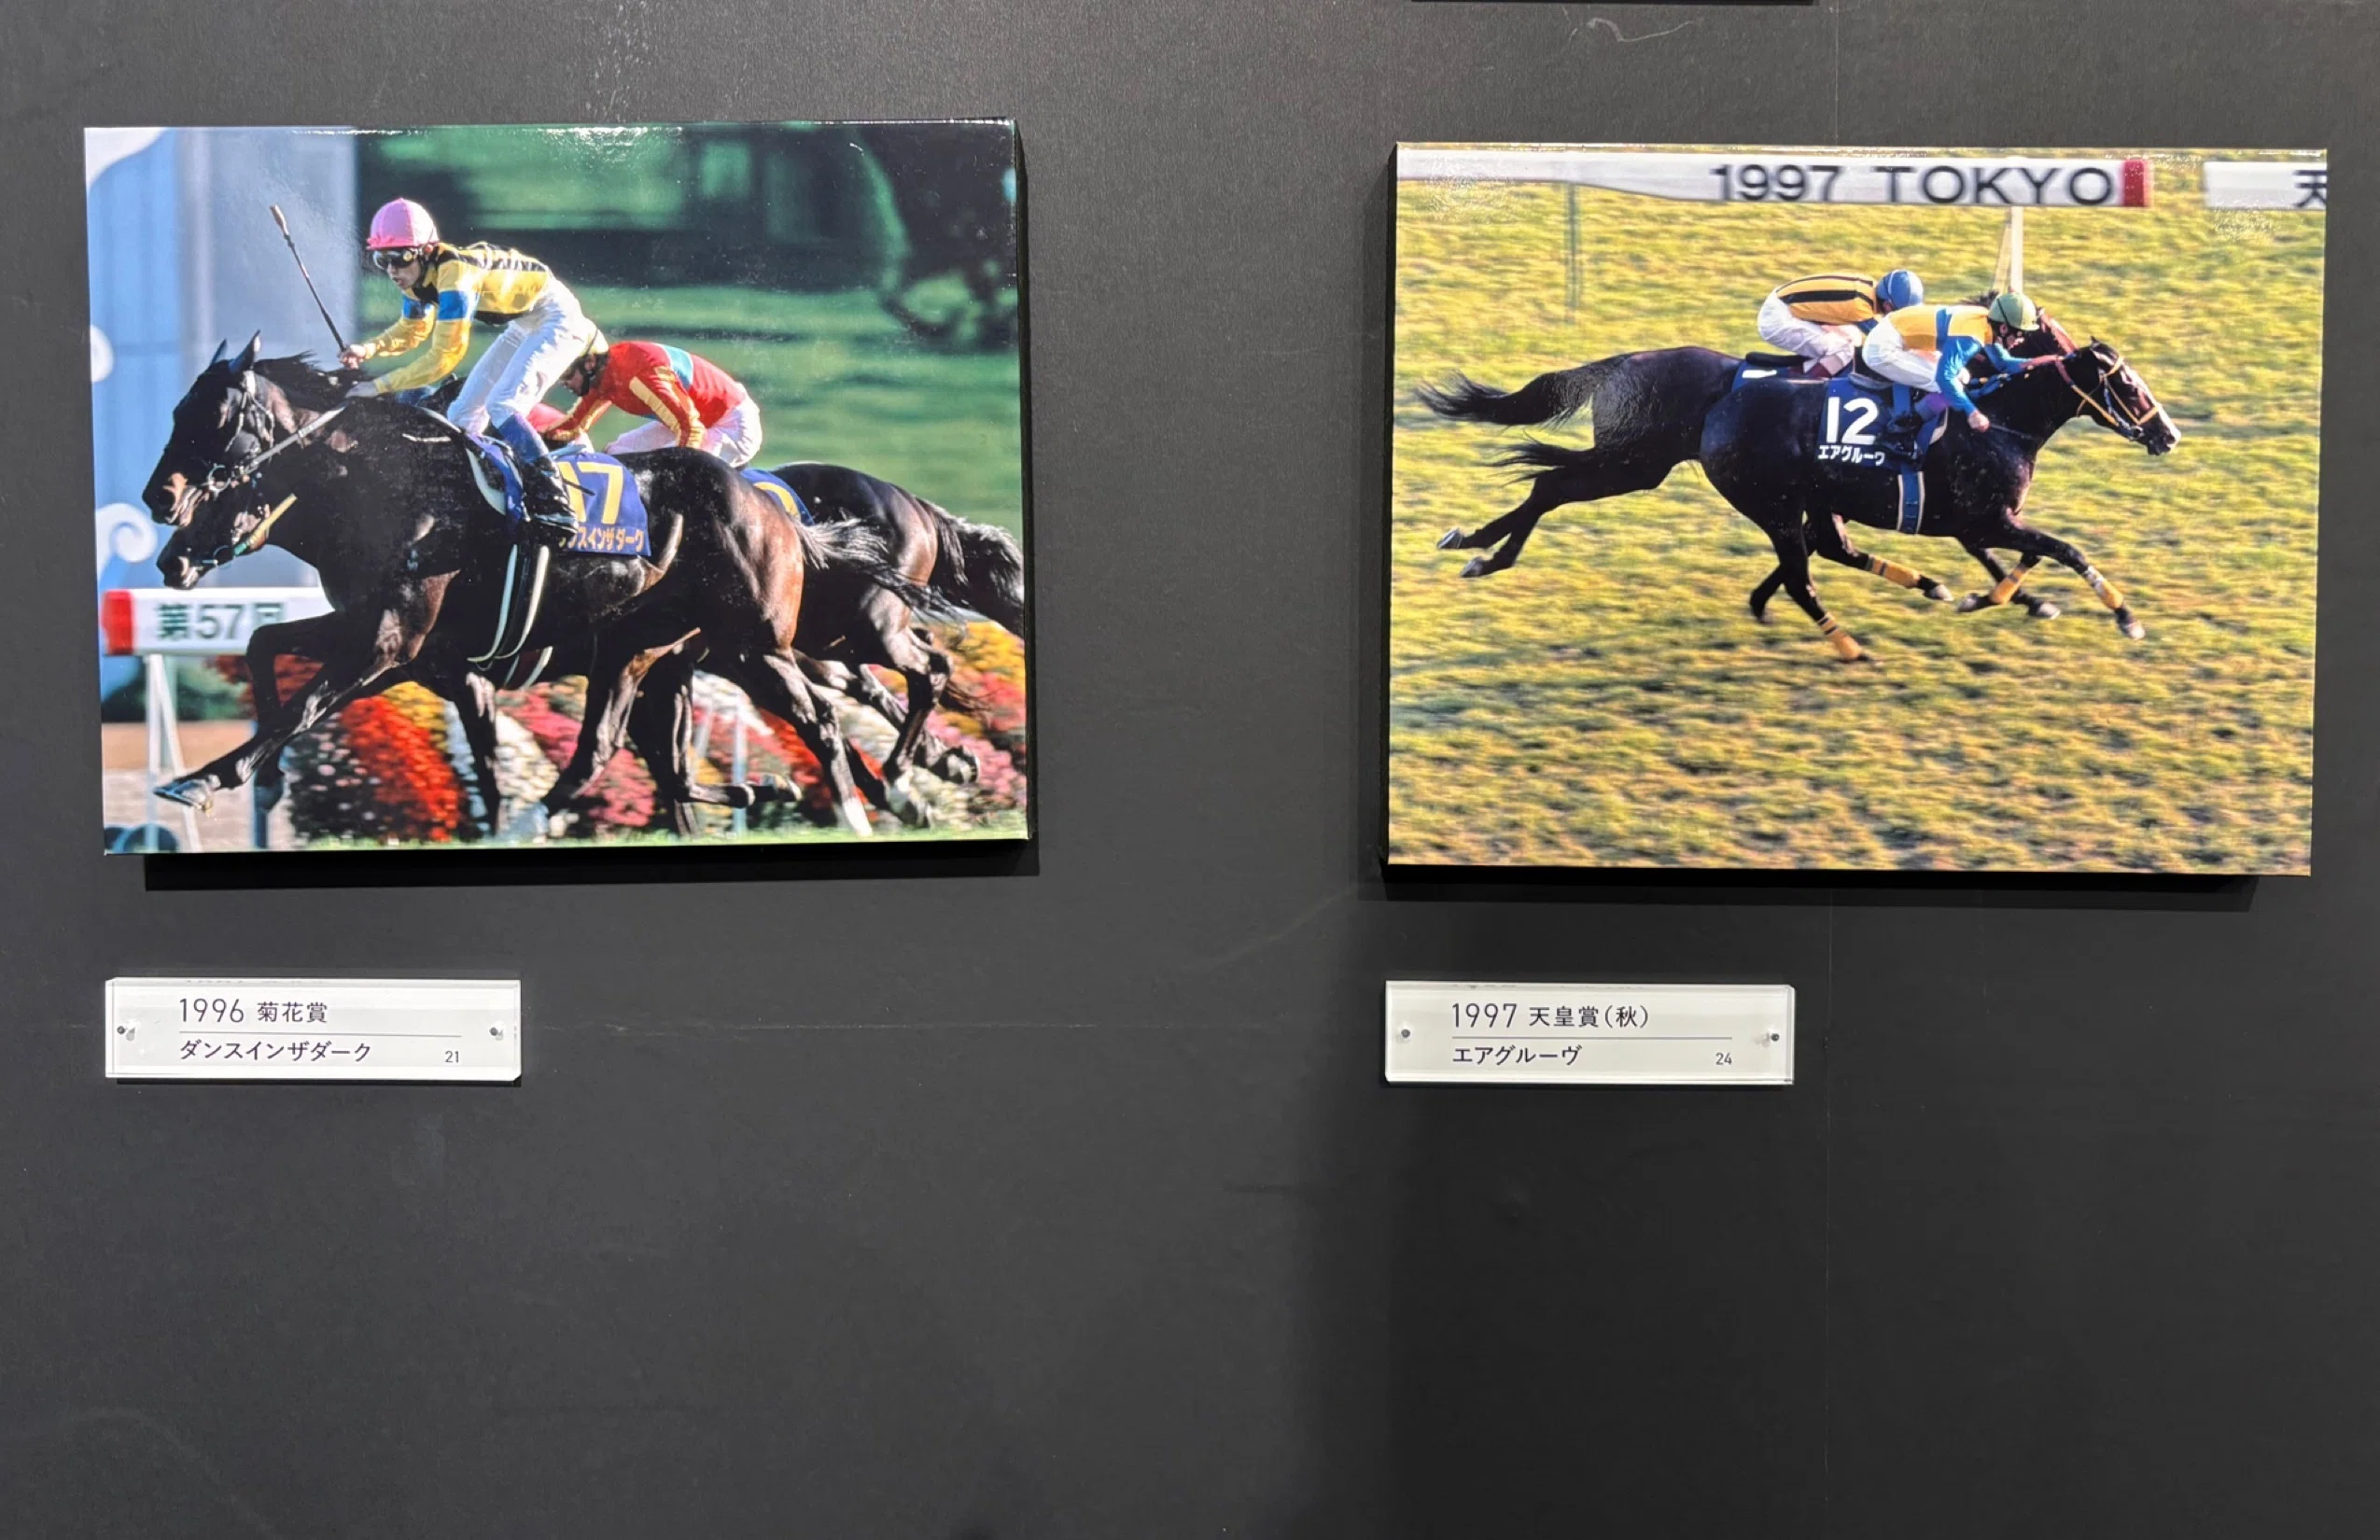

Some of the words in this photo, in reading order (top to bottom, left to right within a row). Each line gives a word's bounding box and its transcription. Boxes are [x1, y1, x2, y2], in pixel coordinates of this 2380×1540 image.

[1709, 164, 1843, 202] 1997
[1873, 165, 2112, 205] TOKYO
[1827, 397, 1879, 445] 12
[557, 461, 623, 525] 17
[179, 998, 245, 1023] 1996
[257, 1001, 328, 1023] 菊花賞
[1452, 1002, 1518, 1028] 1997
[180, 1039, 371, 1062] ダンスインザダーク
[444, 1050, 459, 1063] 21
[1452, 1044, 1583, 1066] エアグルーヴ
[1715, 1052, 1732, 1065] 24
